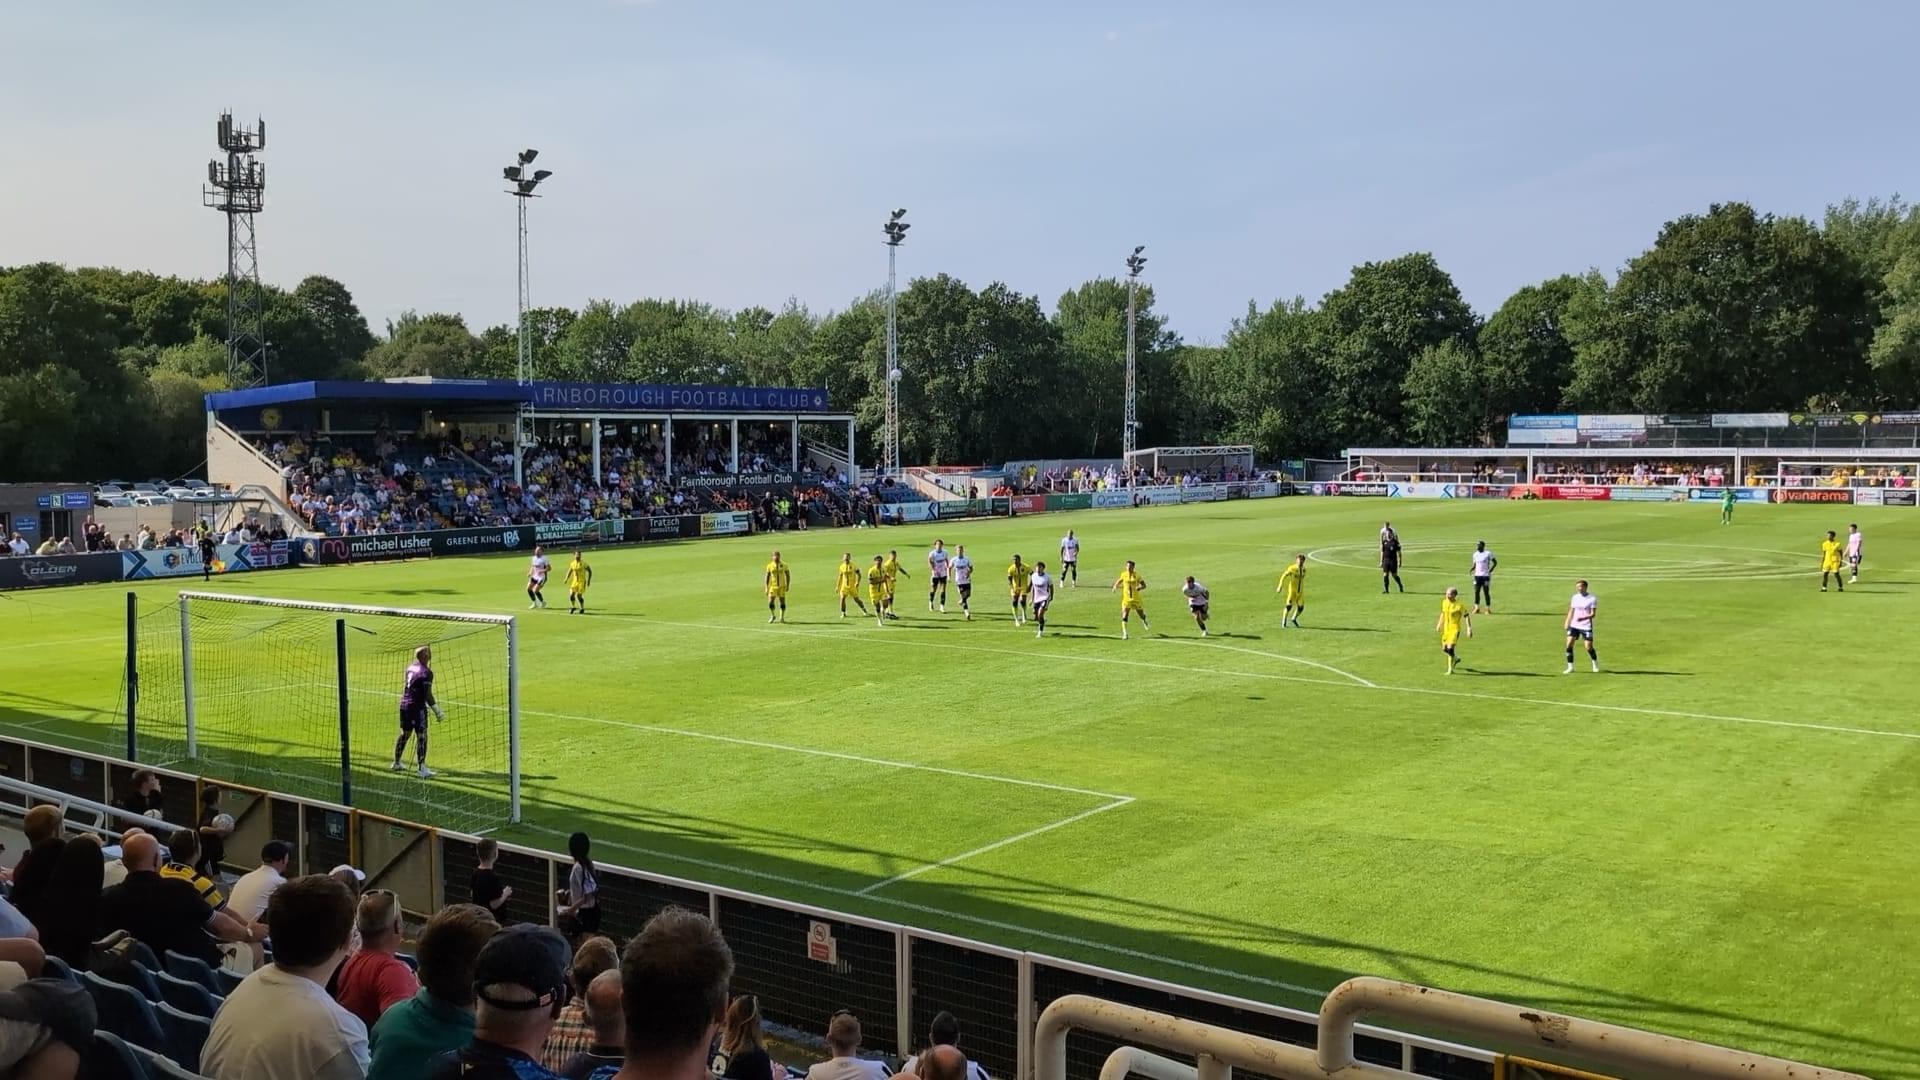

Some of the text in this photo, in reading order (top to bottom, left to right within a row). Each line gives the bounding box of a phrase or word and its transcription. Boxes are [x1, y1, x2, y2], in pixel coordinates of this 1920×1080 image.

[672, 390, 761, 406] FOOTBALL
[767, 392, 809, 407] CLUB
[680, 473, 793, 488] Farnborough Football Club
[1787, 491, 1849, 501] vanarama
[702, 519, 730, 529] Tool Hire
[351, 534, 433, 552] michael usher
[446, 534, 501, 546] GREENE KING
[503, 531, 520, 544] IPA
